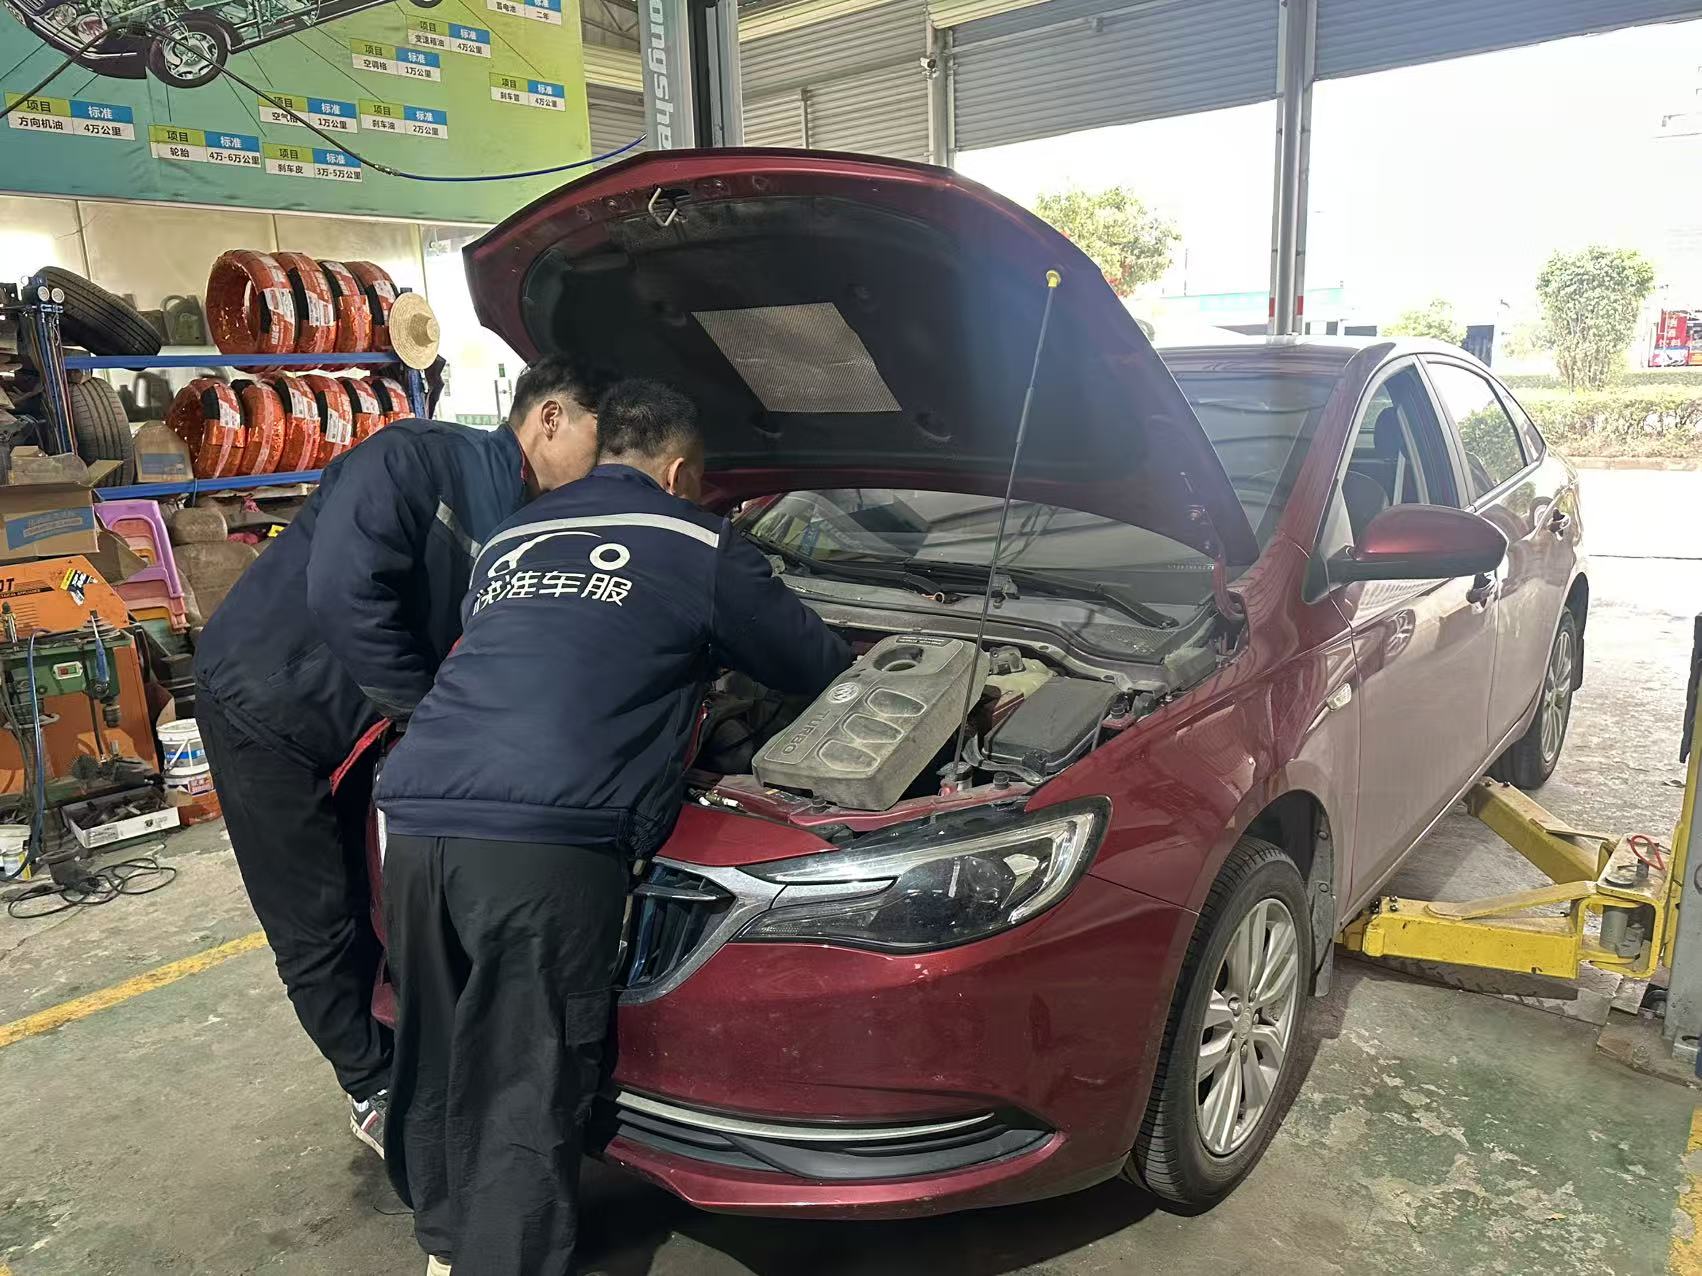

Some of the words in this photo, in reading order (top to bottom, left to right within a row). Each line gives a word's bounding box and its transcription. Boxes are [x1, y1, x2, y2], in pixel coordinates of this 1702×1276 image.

[419, 20, 436, 32] 项目
[460, 28, 477, 40] 标准
[364, 44, 383, 57] 项目
[408, 52, 426, 64] 标准
[457, 42, 483, 55] 4万公里
[363, 58, 387, 71] 空调格
[405, 66, 431, 78] 1万公里
[501, 78, 517, 88] 项目
[537, 84, 553, 94] 标准
[26, 100, 51, 113] 项目
[87, 105, 113, 119] 标准
[321, 102, 341, 115] 标准
[534, 97, 557, 108] 4万公里
[373, 104, 391, 116] 项目
[415, 110, 433, 122] 标准
[18, 116, 64, 130] 方向机油
[83, 124, 122, 136] 4万公里
[318, 118, 348, 130] 1万公里
[372, 119, 396, 130] 刹车油
[412, 125, 439, 136] 2万公里
[166, 129, 189, 142] 项目
[220, 136, 242, 149] 标准
[169, 146, 190, 158] 轮胎
[208, 151, 260, 165] 4万-6万公里
[279, 148, 299, 159] 项目
[326, 153, 345, 164] 标准
[277, 163, 303, 174] 刹车皮
[316, 167, 361, 180] 3万-5万公里
[782, 707, 831, 755] TURBO
